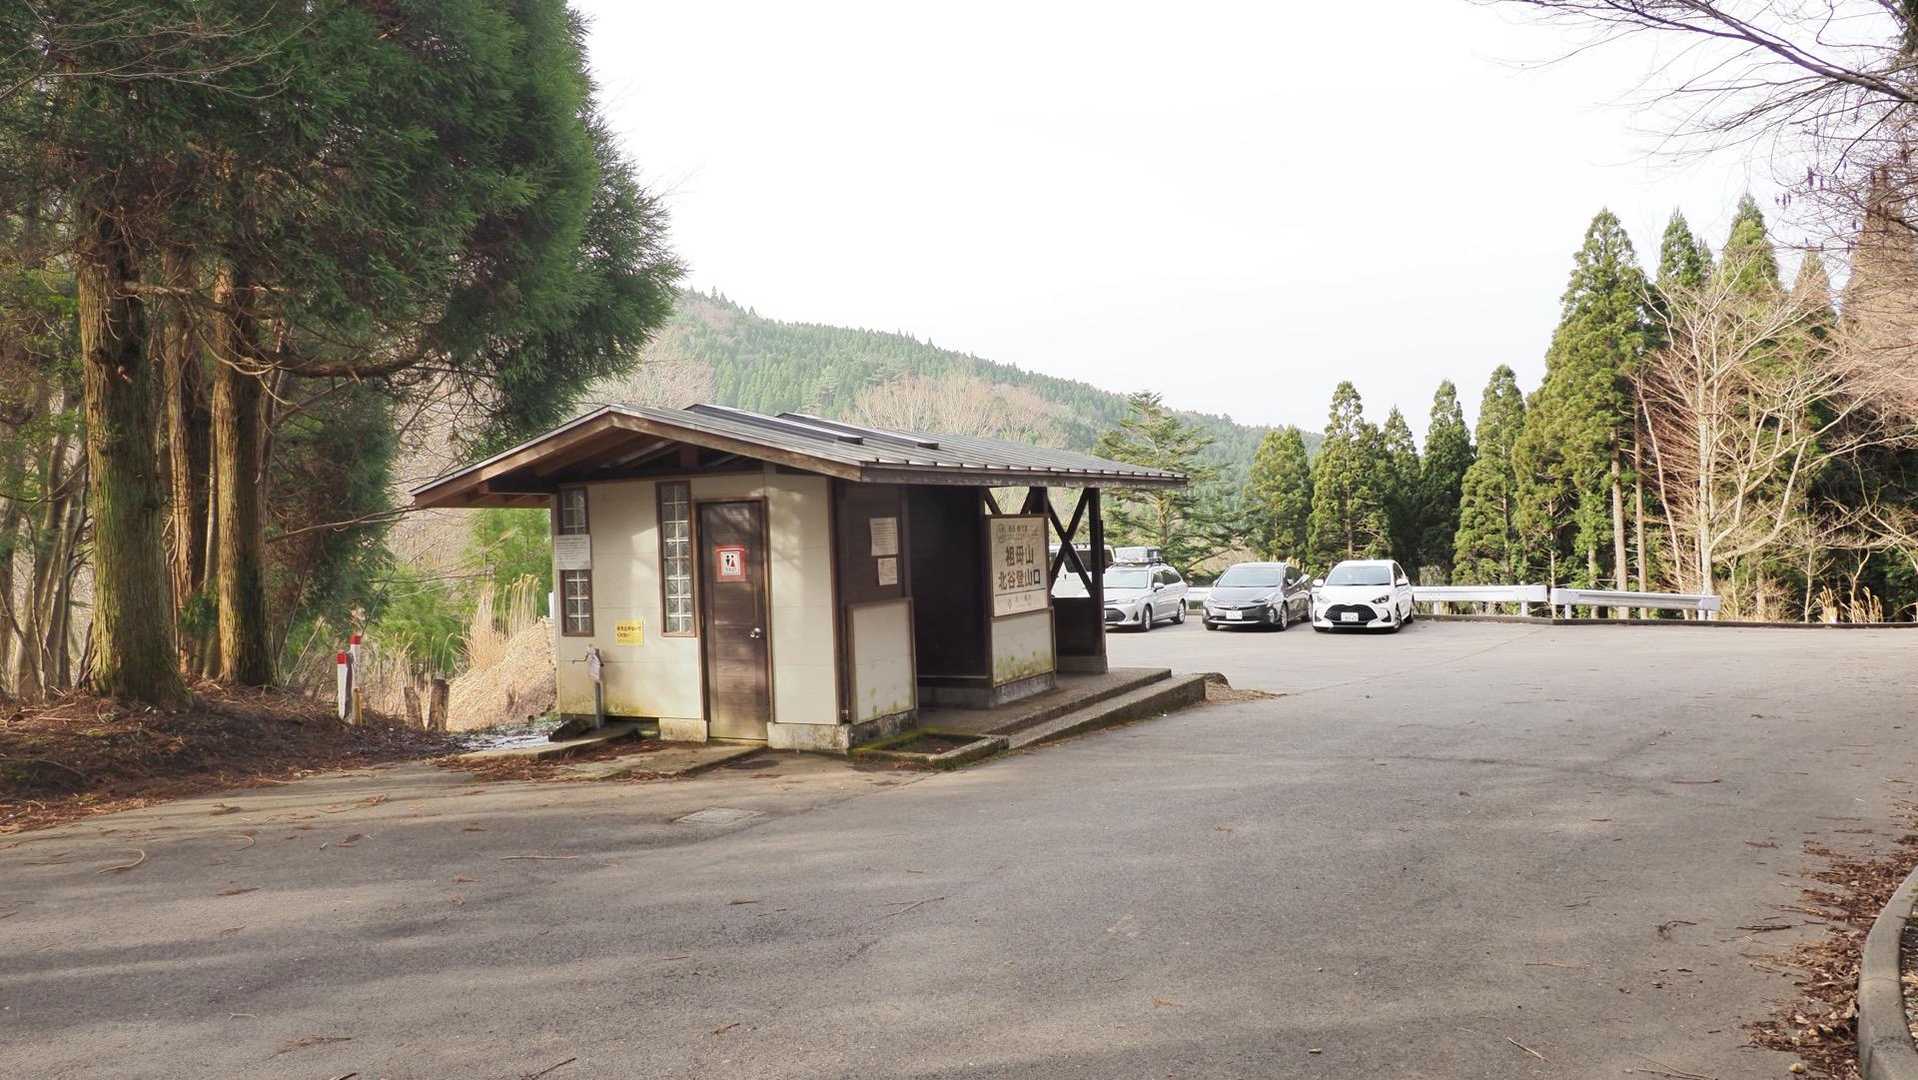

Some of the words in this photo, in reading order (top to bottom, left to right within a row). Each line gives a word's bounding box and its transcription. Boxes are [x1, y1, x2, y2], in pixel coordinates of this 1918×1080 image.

[1006, 545, 1034, 566] 祖母山
[998, 569, 1041, 590] 北谷登山口
